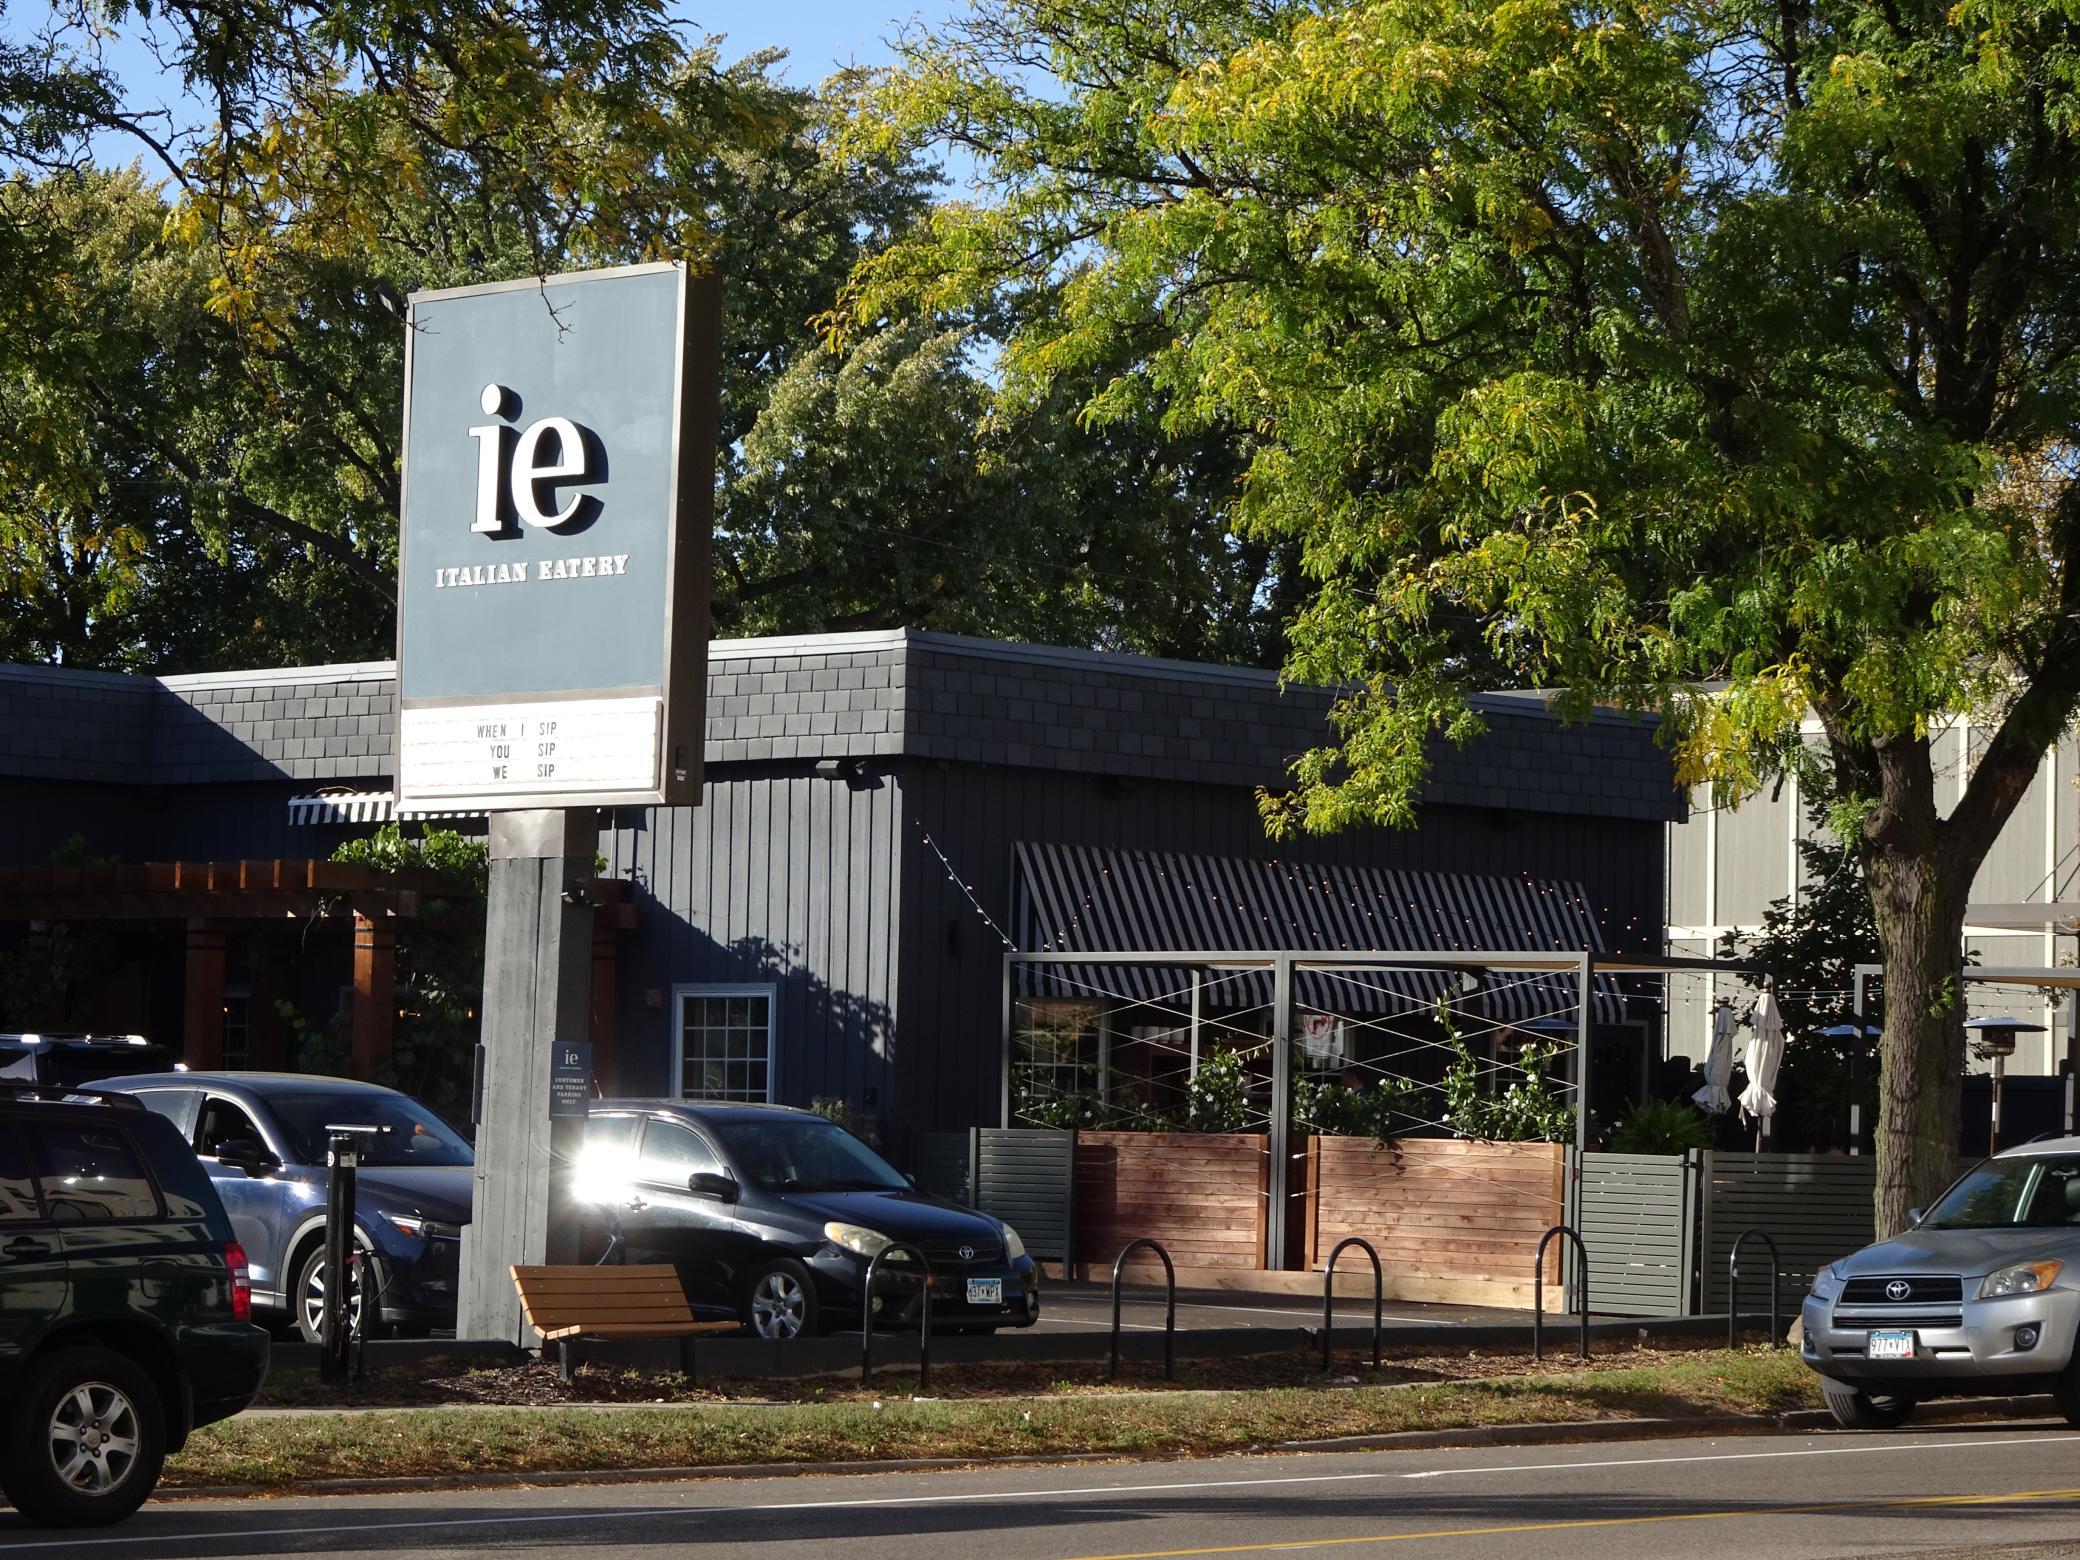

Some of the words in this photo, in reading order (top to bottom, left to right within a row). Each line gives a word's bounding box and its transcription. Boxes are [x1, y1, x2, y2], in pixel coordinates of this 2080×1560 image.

[468, 383, 592, 535] ie
[435, 562, 529, 588] ITALIAN
[538, 554, 630, 580] EATERY
[477, 723, 507, 738] WHEN
[521, 722, 525, 737] I
[539, 721, 557, 736] SIP
[490, 744, 510, 759] YOU
[538, 742, 556, 757] SIP
[493, 765, 508, 780] WE
[537, 763, 555, 778] SIP
[564, 1049, 579, 1065] ie
